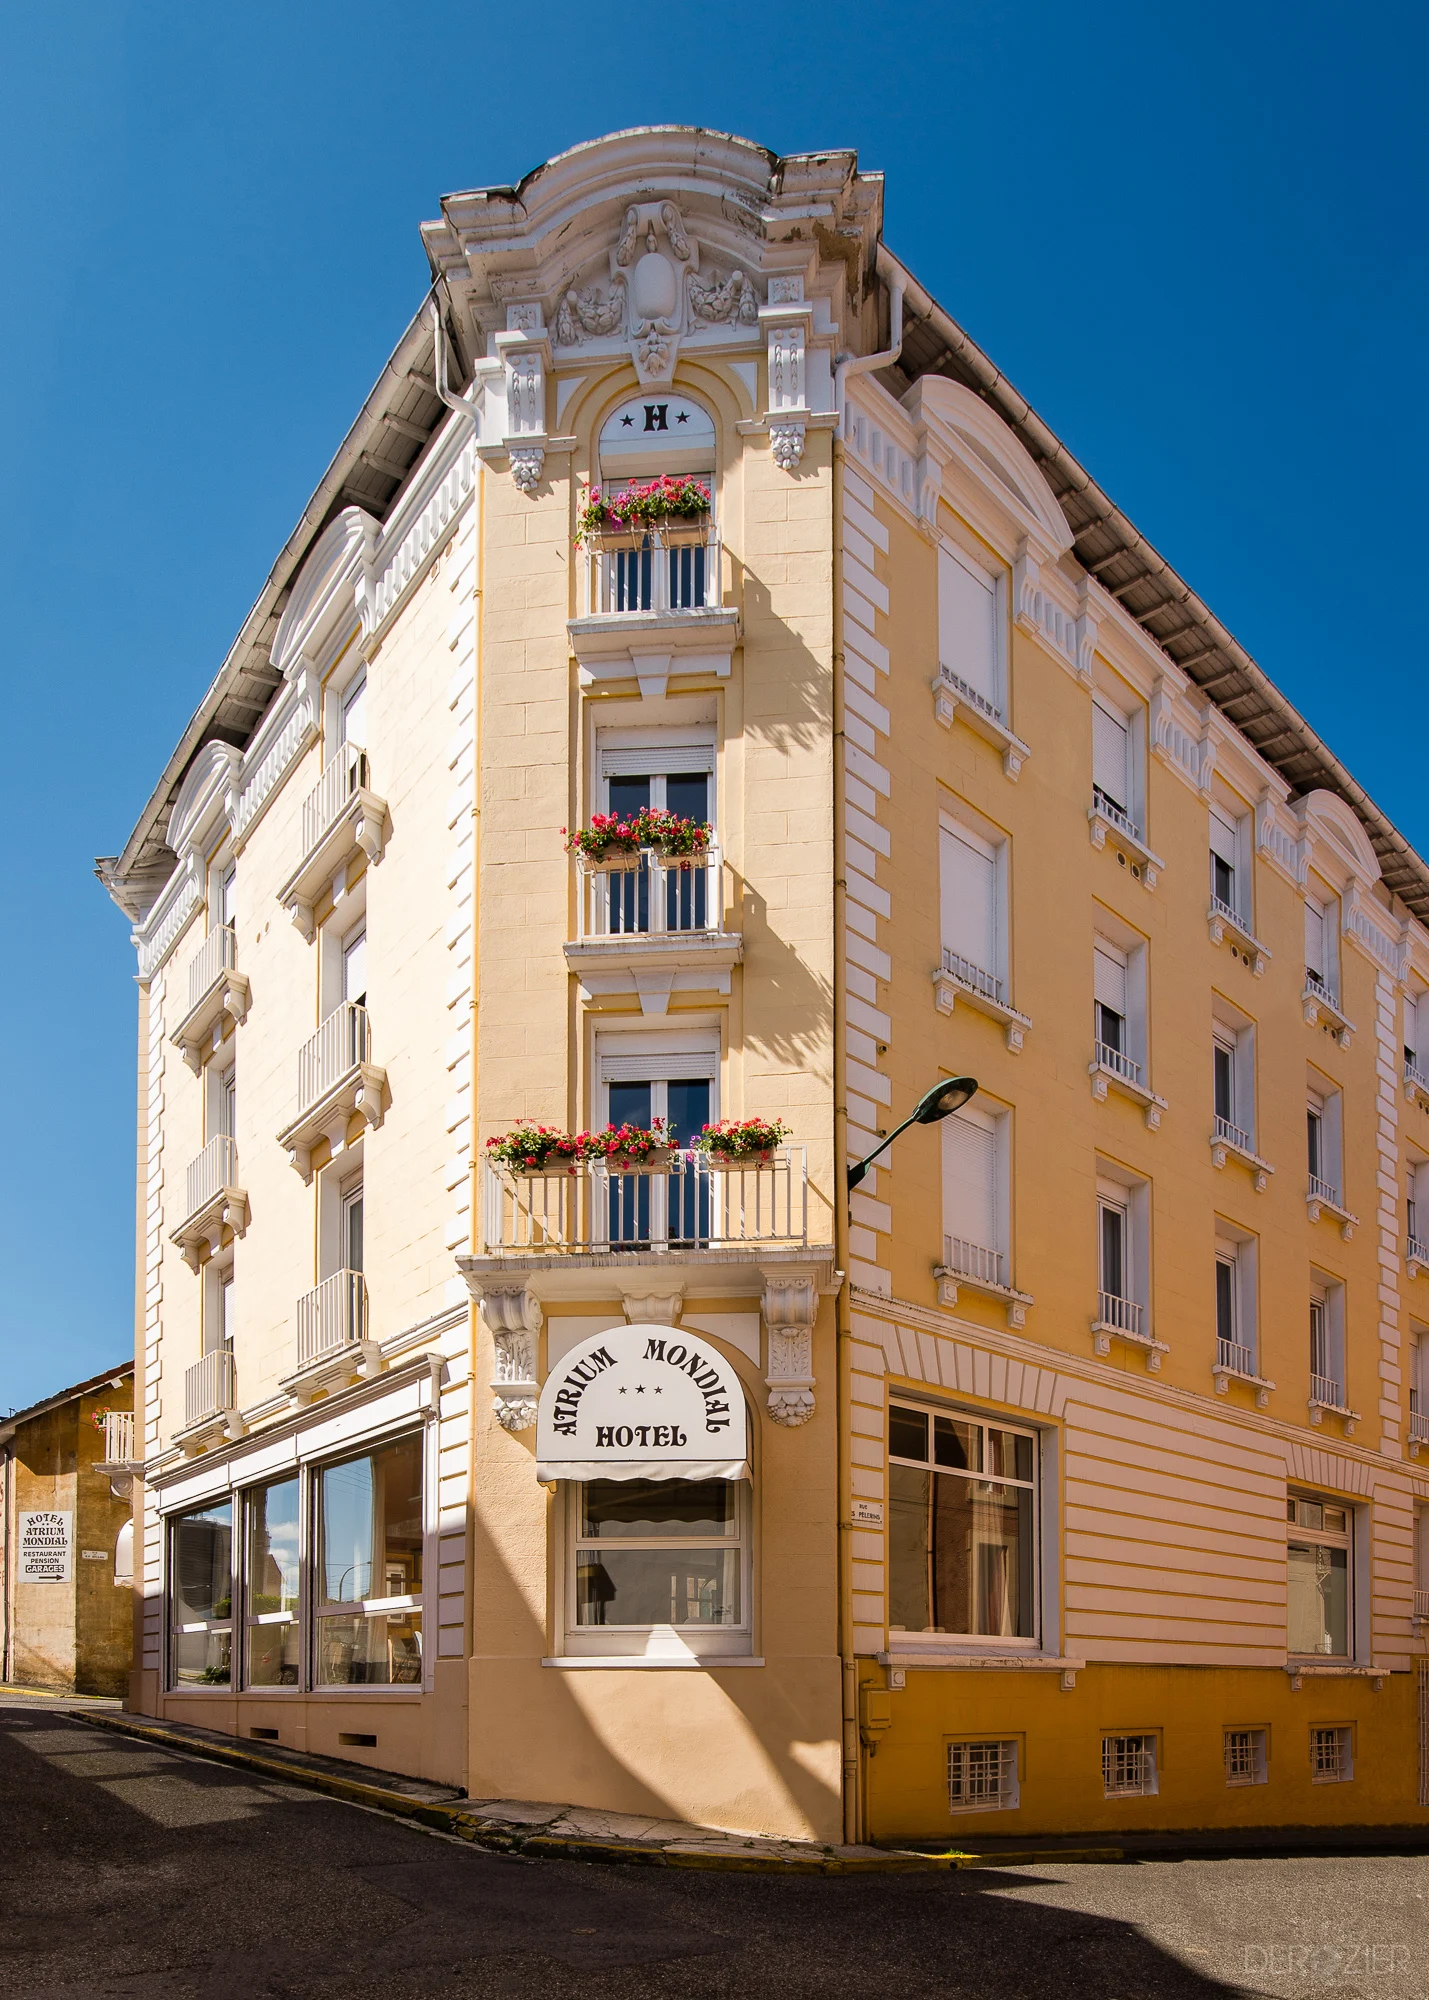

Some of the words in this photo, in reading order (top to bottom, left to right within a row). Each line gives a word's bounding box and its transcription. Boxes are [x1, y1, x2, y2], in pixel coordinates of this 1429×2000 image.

[643, 404, 669, 432] H
[553, 1346, 618, 1436] ATRIUM
[642, 1338, 730, 1434] MONDIAL
[595, 1425, 687, 1448] HOTEL
[26, 1513, 64, 1527] HOTEL
[25, 1527, 65, 1536] ATRIUM
[22, 1537, 68, 1546] MONDIAL
[26, 1565, 64, 1573] GARAGES
